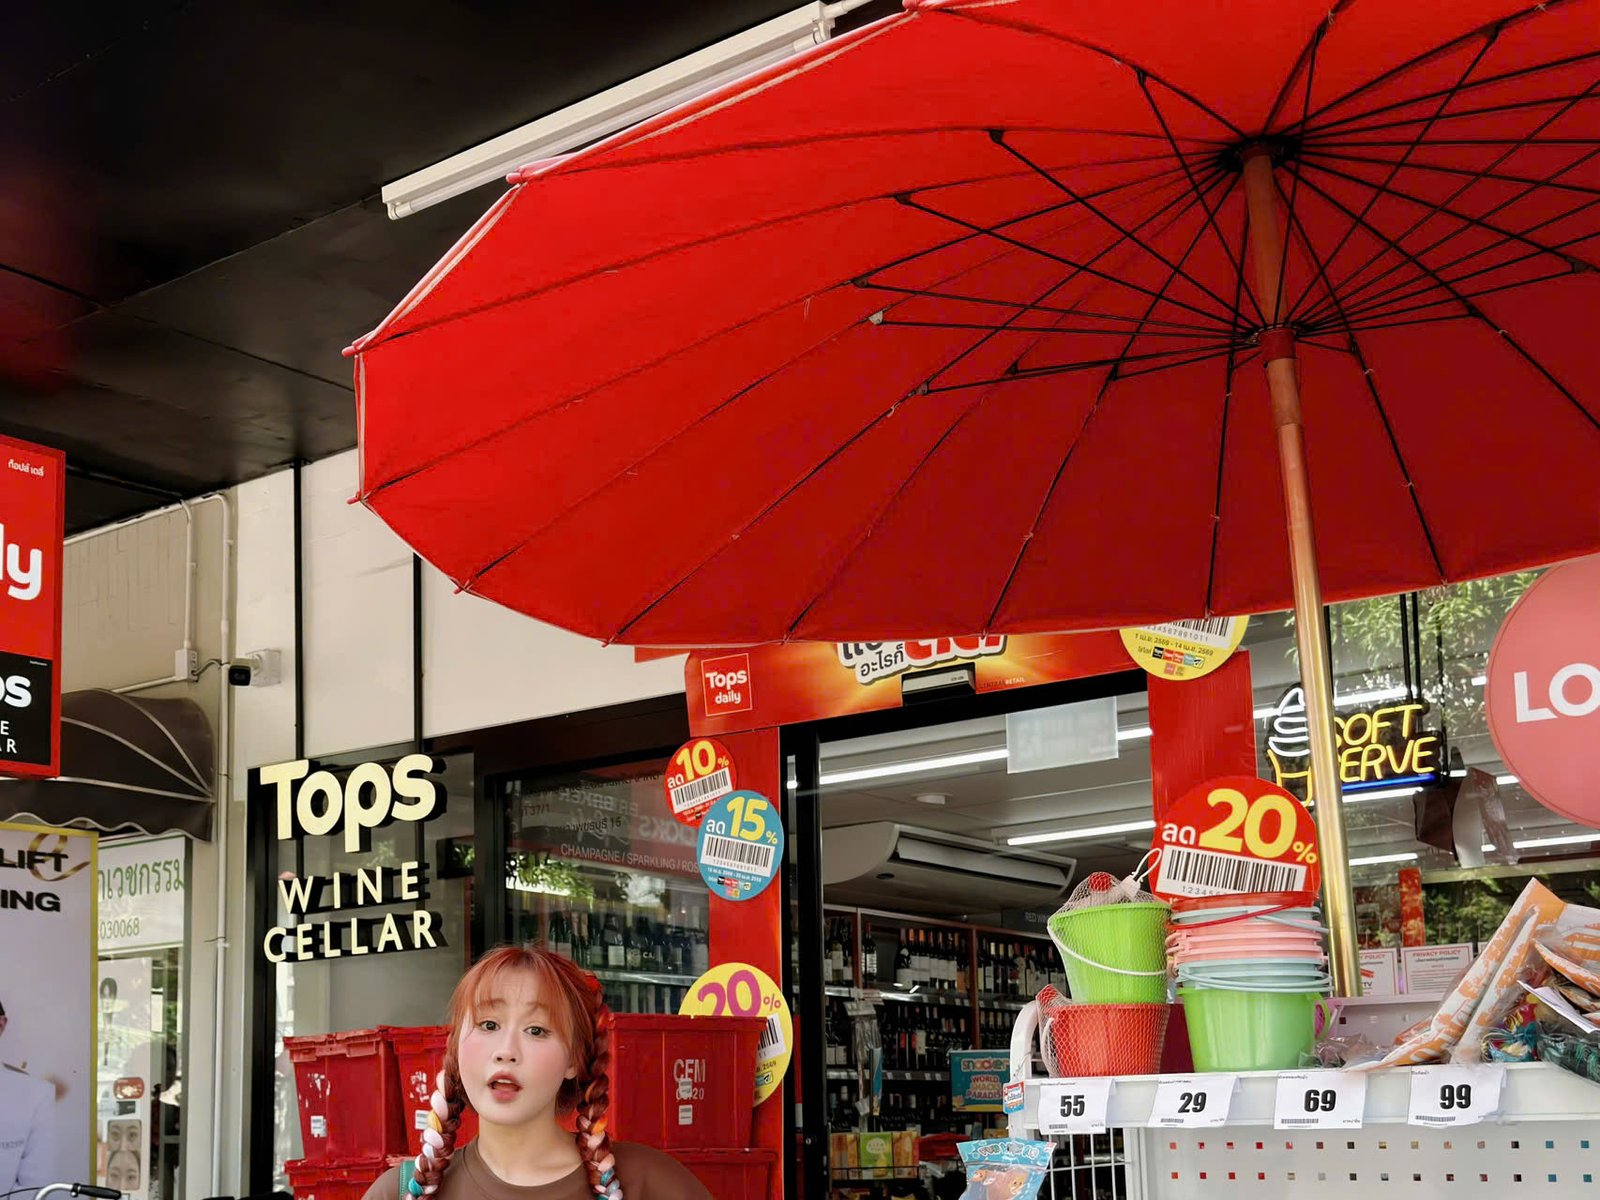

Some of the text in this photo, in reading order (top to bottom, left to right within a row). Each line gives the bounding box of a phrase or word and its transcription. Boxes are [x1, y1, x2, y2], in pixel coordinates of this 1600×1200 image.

[704, 669, 748, 690] Tops
[714, 690, 742, 704] daily
[1337, 736, 1437, 783] ERVE
[259, 753, 436, 853] Tops
[705, 819, 726, 835] ลด
[1161, 823, 1197, 846] ลด
[560, 843, 623, 863] CHAMPAGNE
[627, 853, 676, 871] SPARKLING
[278, 861, 419, 914] WINE
[0, 889, 61, 912] ING
[263, 909, 437, 963] CELLAR
[1412, 949, 1461, 958] PRIVACY POLICY
[1060, 1094, 1085, 1117] 55
[1177, 1092, 1207, 1114] 29
[1304, 1089, 1337, 1113] 69
[1440, 1084, 1472, 1110] 99
